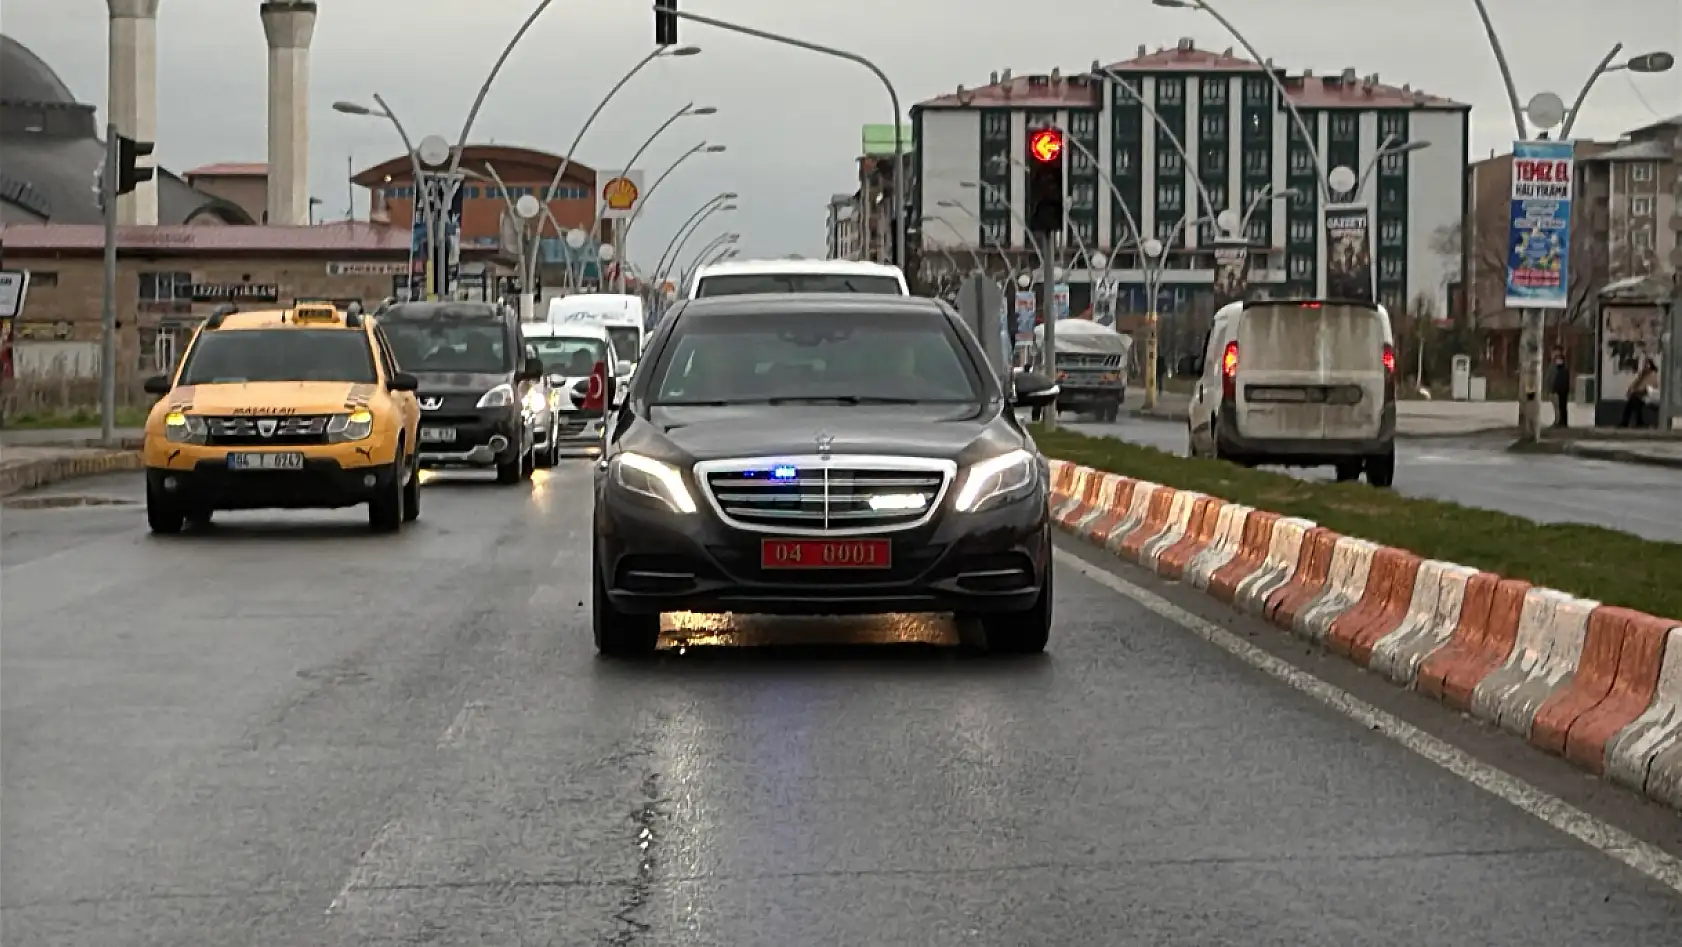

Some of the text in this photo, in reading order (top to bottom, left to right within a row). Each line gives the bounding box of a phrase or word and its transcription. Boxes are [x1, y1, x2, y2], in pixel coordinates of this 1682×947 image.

[1555, 160, 1569, 182] EL
[235, 453, 249, 467] 04
[775, 543, 876, 563] 04 0001
